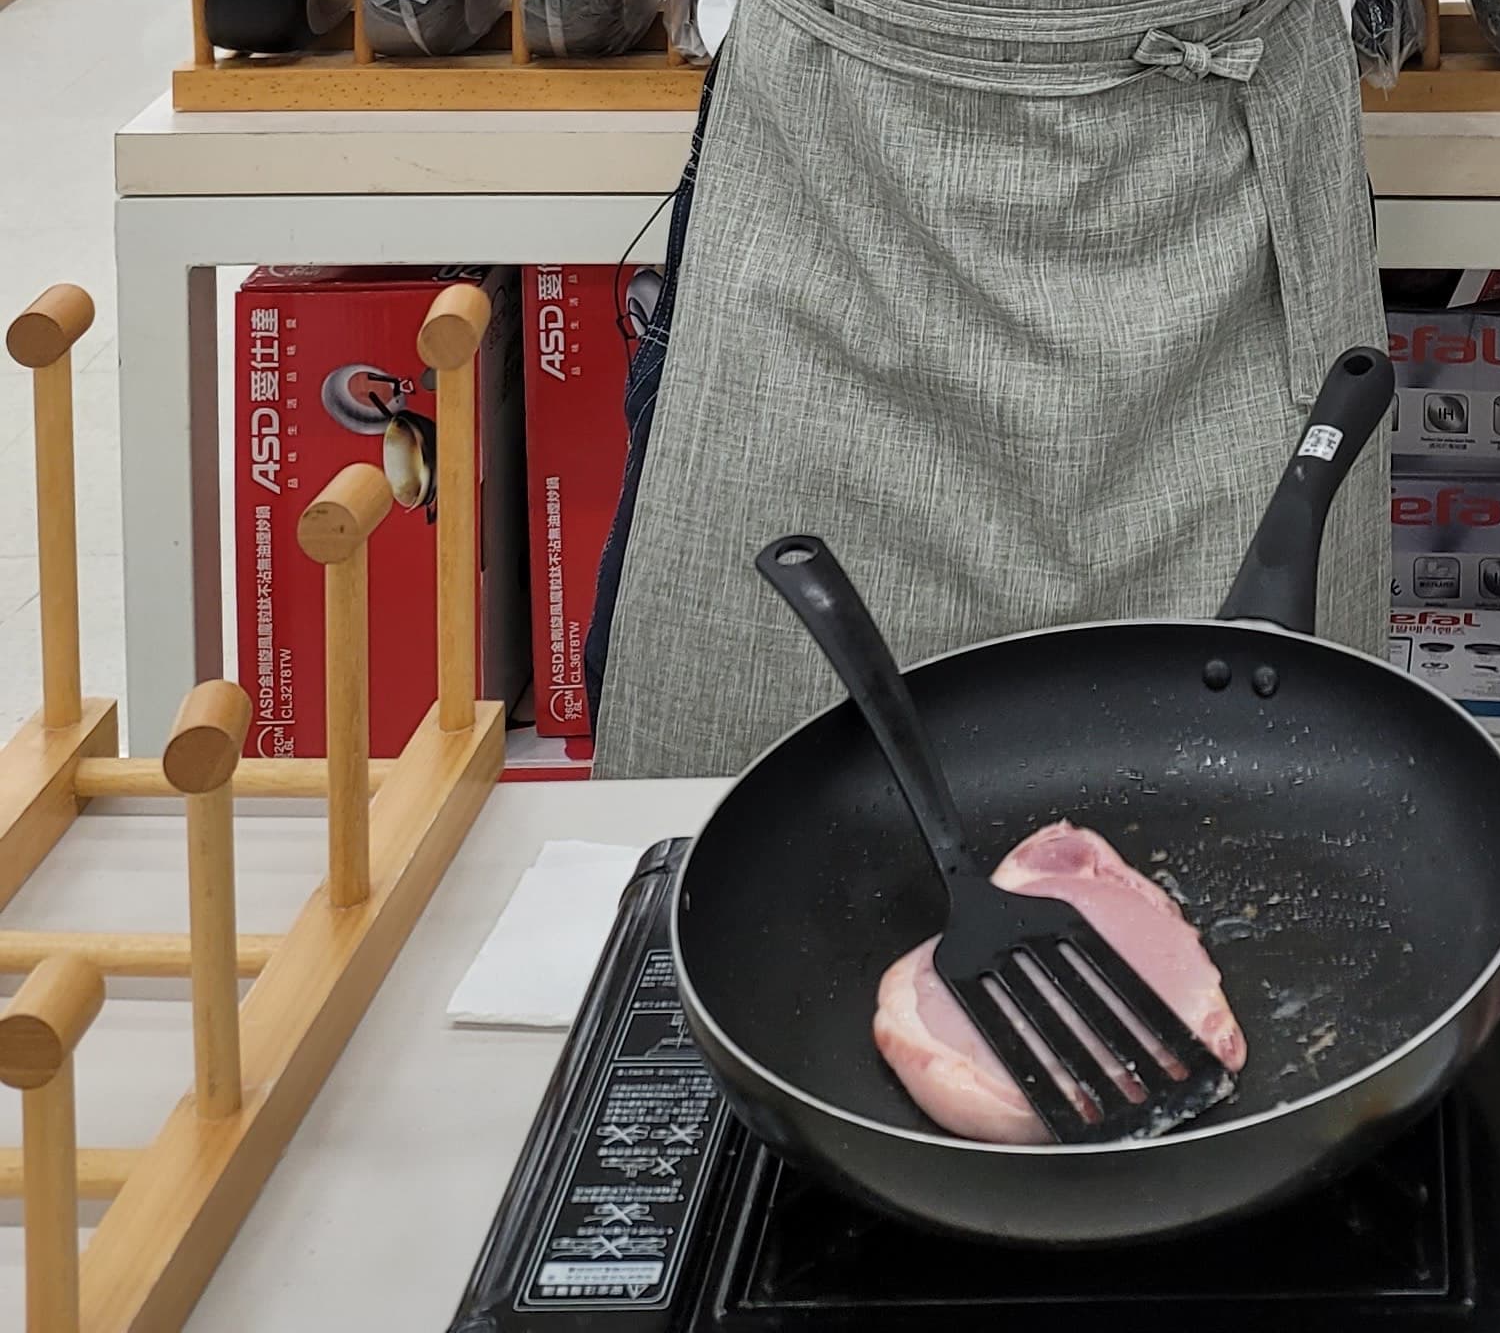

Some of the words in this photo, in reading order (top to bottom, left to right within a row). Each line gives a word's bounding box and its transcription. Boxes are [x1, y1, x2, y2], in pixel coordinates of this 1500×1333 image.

[251, 307, 280, 403] 愛仕達
[539, 305, 566, 381] ASD
[251, 407, 281, 495] ASD
[1438, 408, 1454, 420] IH
[1390, 611, 1481, 628] efal
[280, 648, 293, 720] CL32T8TW
